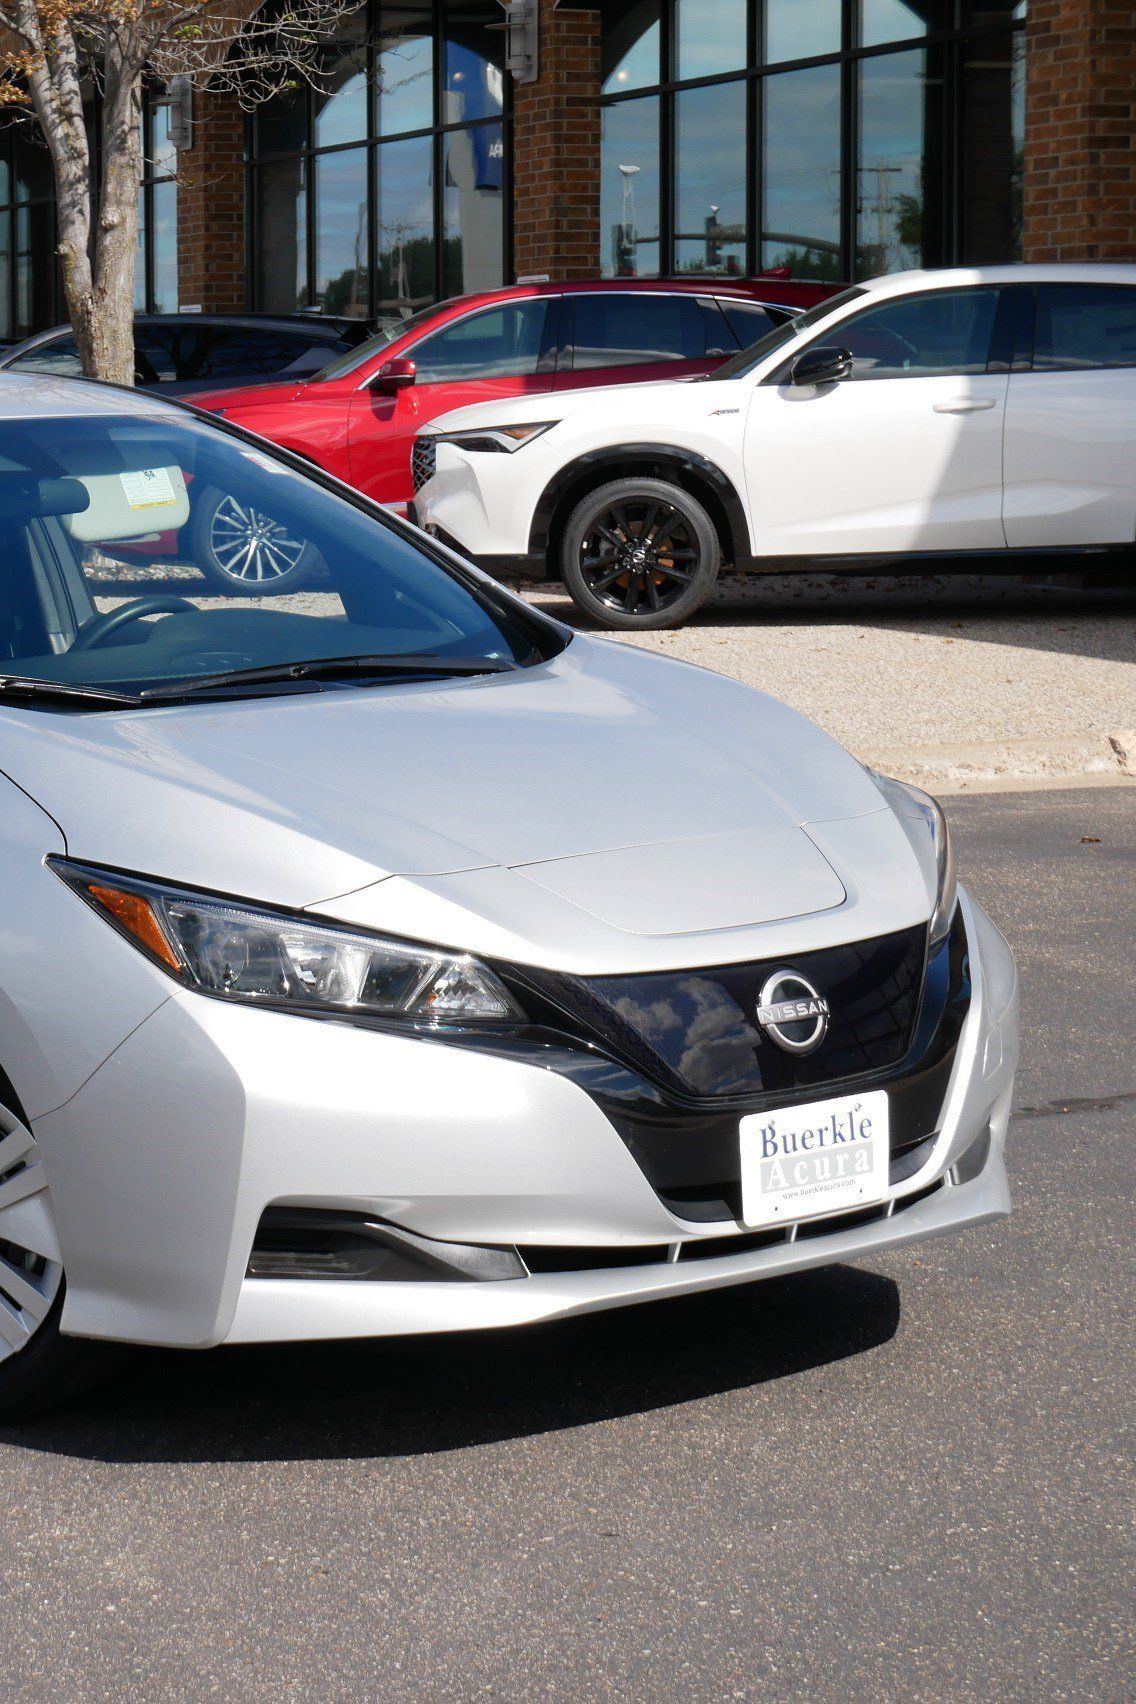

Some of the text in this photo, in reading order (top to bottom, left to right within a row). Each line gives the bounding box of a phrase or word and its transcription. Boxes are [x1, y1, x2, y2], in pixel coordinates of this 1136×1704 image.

[761, 999, 828, 1021] NISSAN
[758, 1110, 873, 1159] Buerkle
[765, 1148, 870, 1191] Acura
